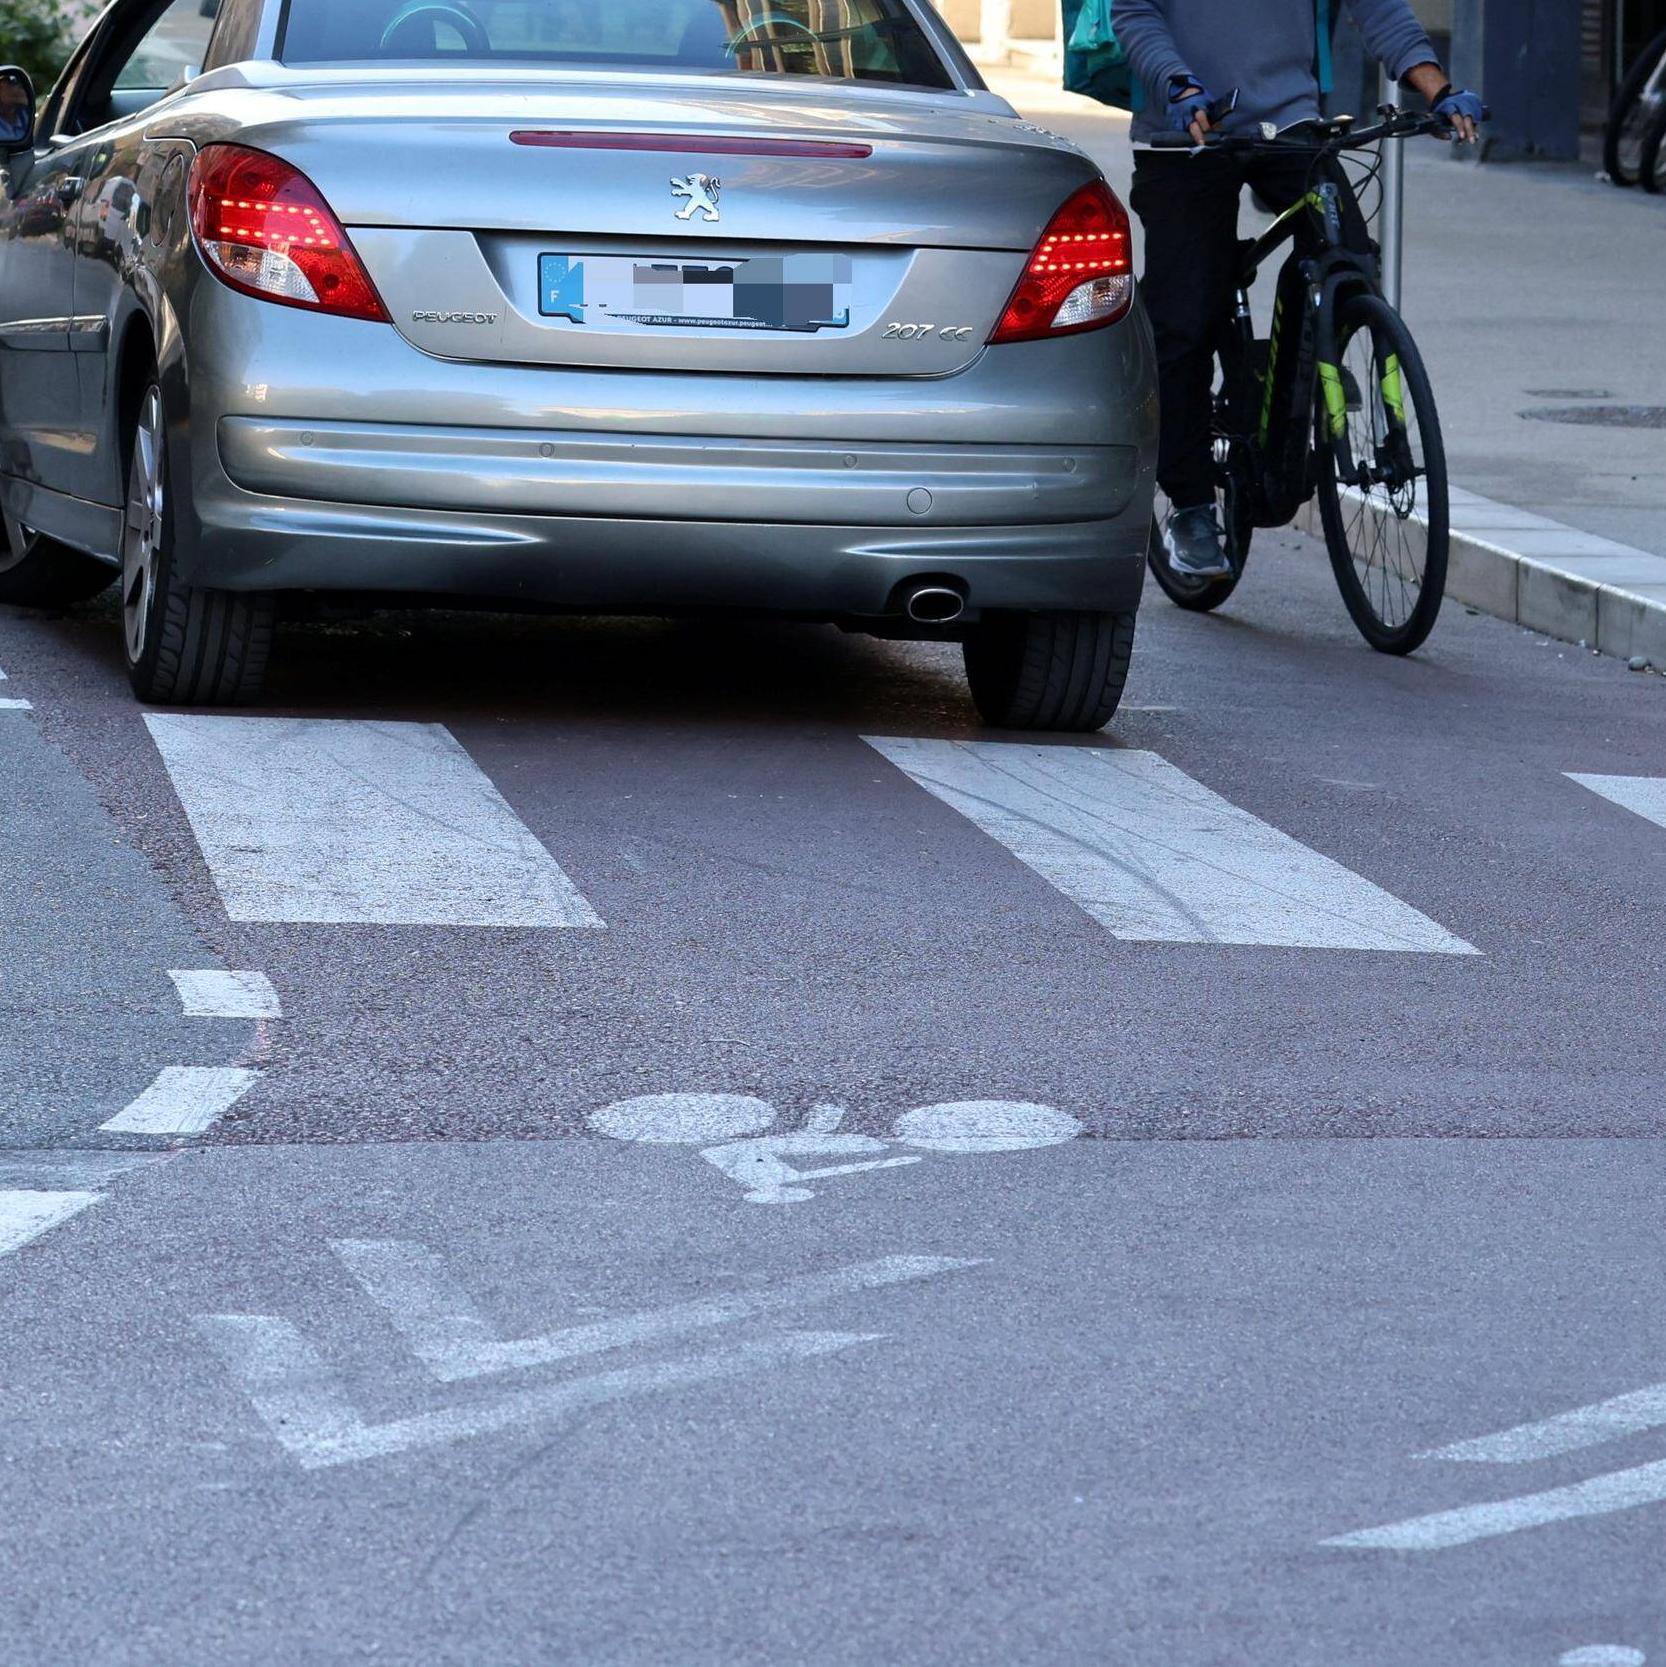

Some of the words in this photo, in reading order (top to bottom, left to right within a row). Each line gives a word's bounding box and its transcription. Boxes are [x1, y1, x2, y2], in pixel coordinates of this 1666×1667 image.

[550, 290, 560, 303] F
[413, 310, 497, 324] PEUGEOT
[652, 316, 673, 324] AZUR
[882, 322, 935, 340] 207
